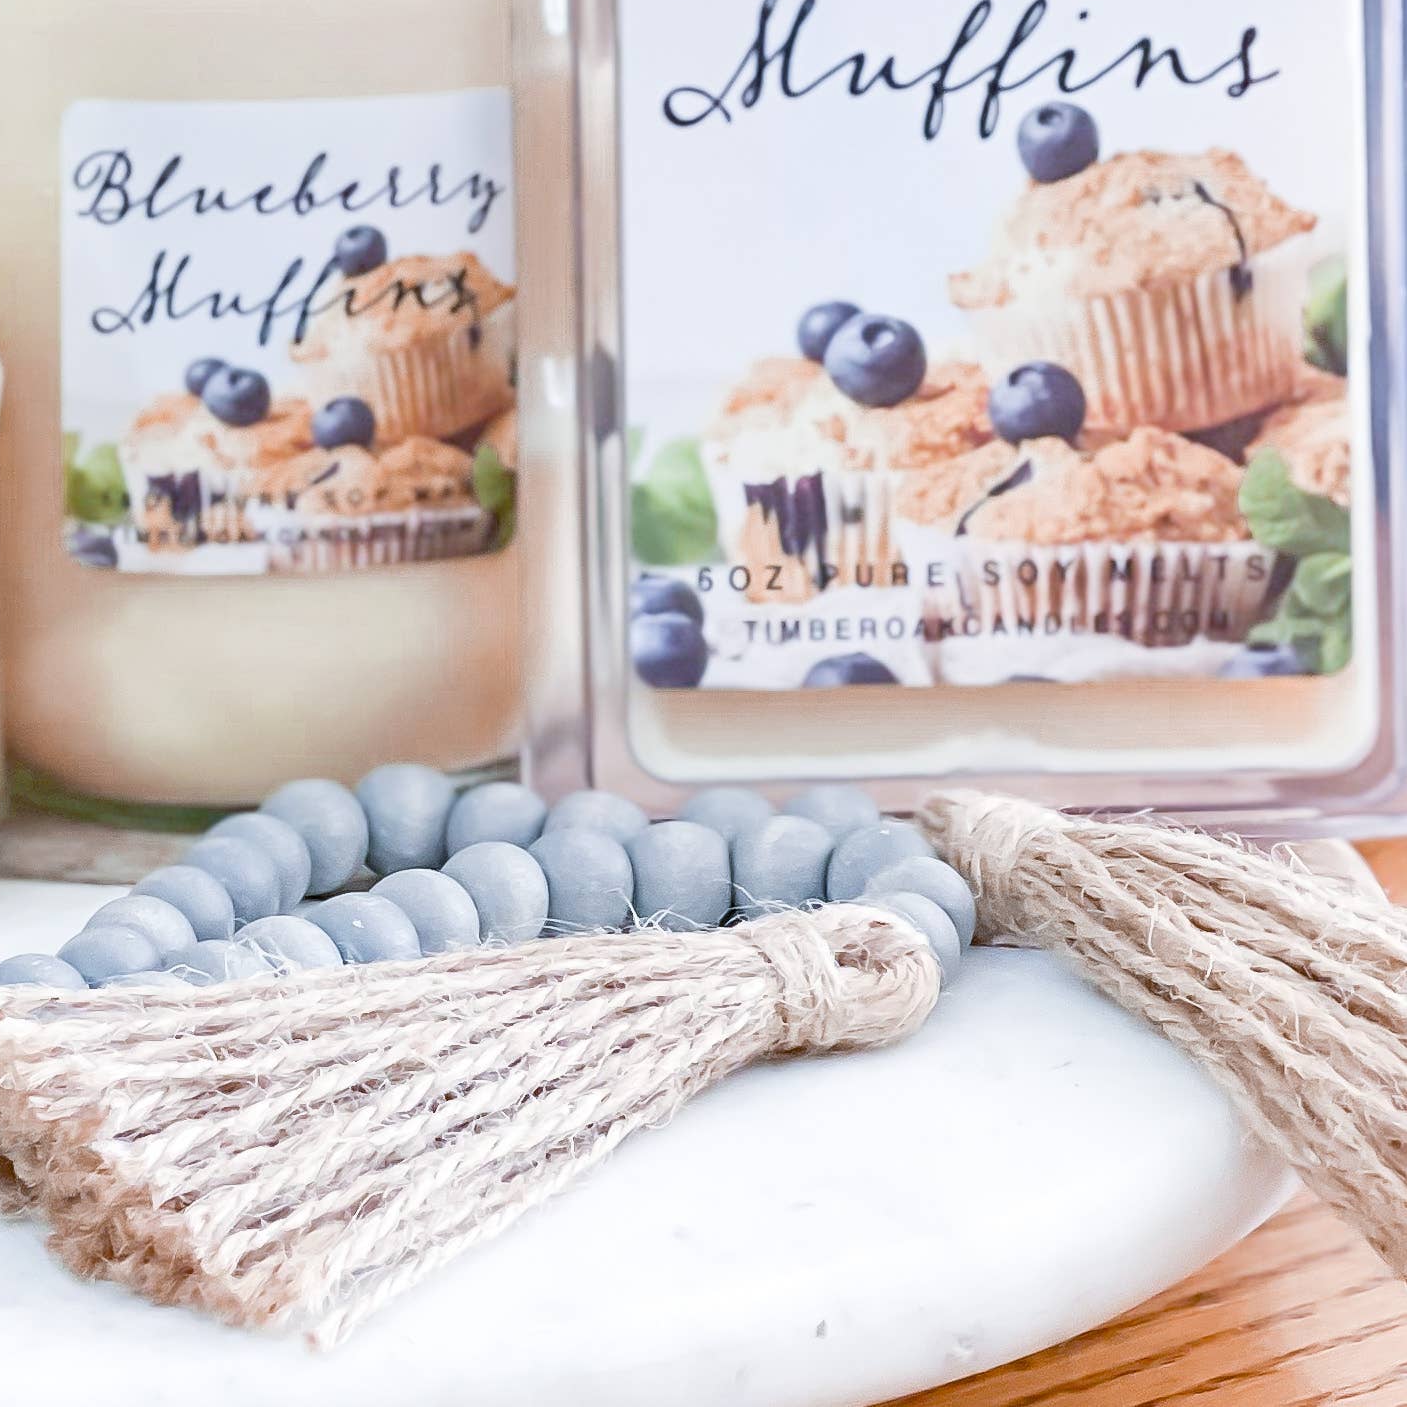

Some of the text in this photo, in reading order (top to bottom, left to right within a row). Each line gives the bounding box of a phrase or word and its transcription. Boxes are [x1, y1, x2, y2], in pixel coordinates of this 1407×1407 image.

[73, 148, 506, 234] Blueberry
[91, 249, 478, 347] Muffins
[696, 553, 1267, 592] 6OZ PURE SOY MELTS
